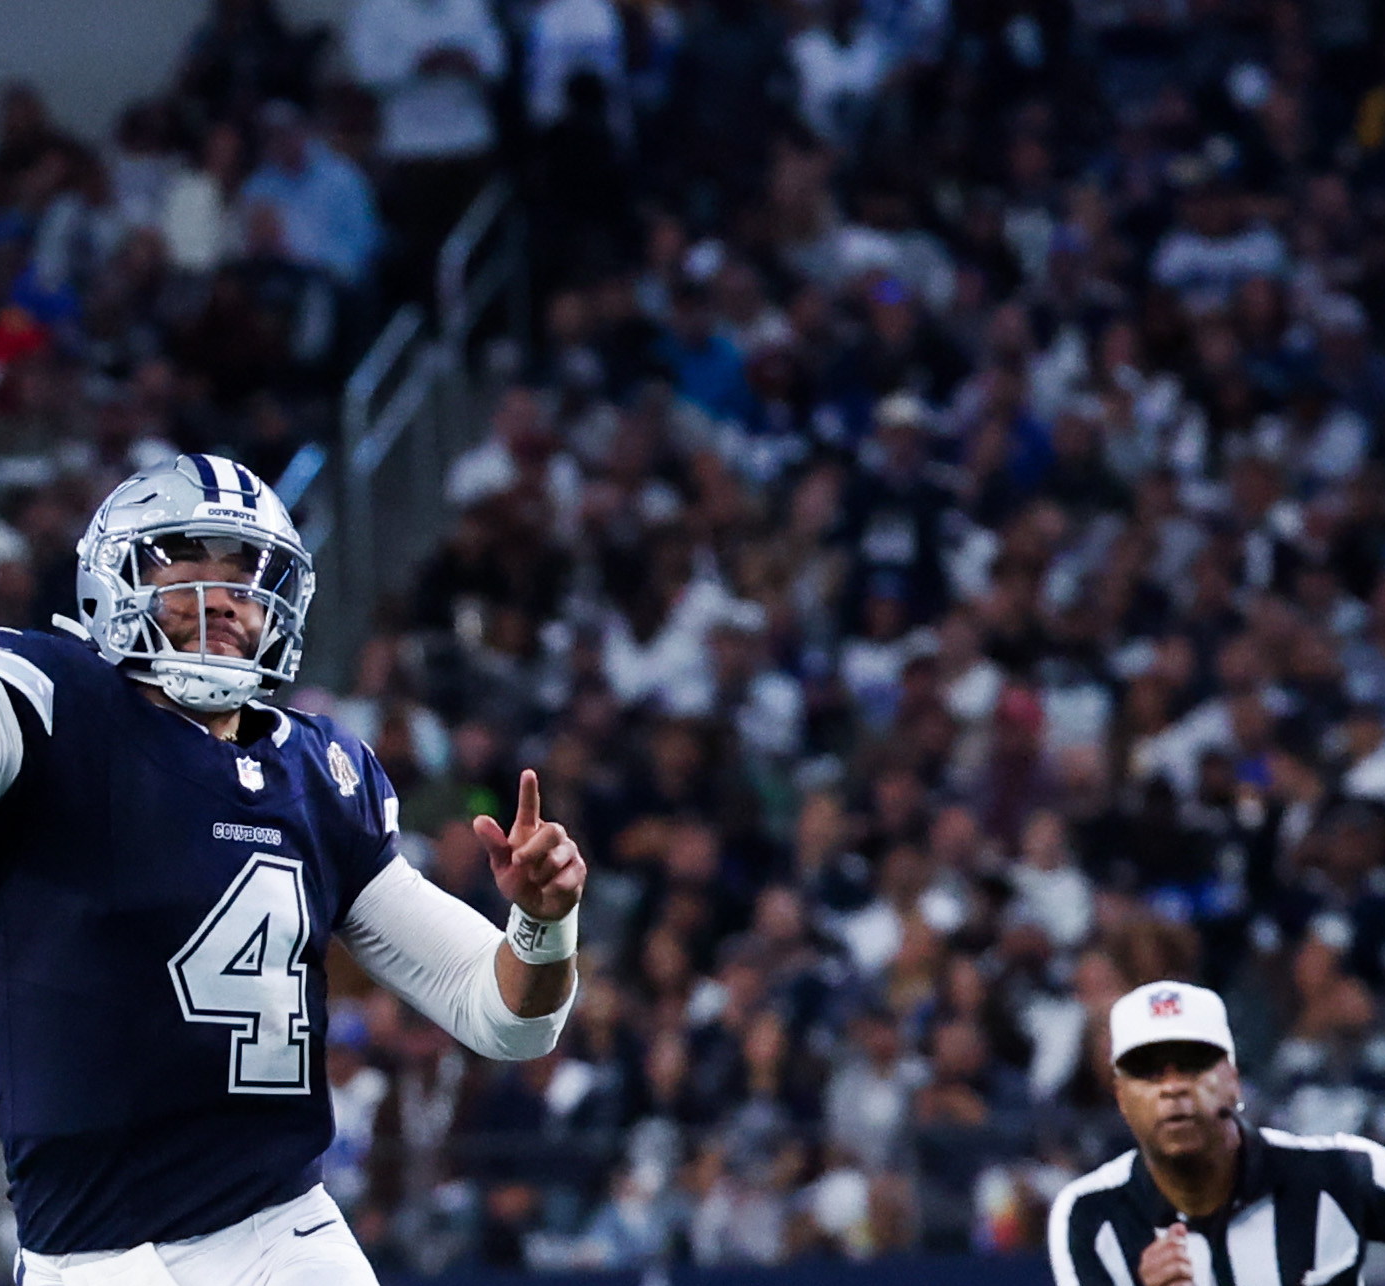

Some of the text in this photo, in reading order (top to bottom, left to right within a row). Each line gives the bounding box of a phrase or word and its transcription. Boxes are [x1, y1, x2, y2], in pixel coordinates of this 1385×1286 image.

[208, 508, 256, 522] COWBOYS
[212, 822, 282, 846] COWBOYS
[167, 852, 311, 1095] 4
